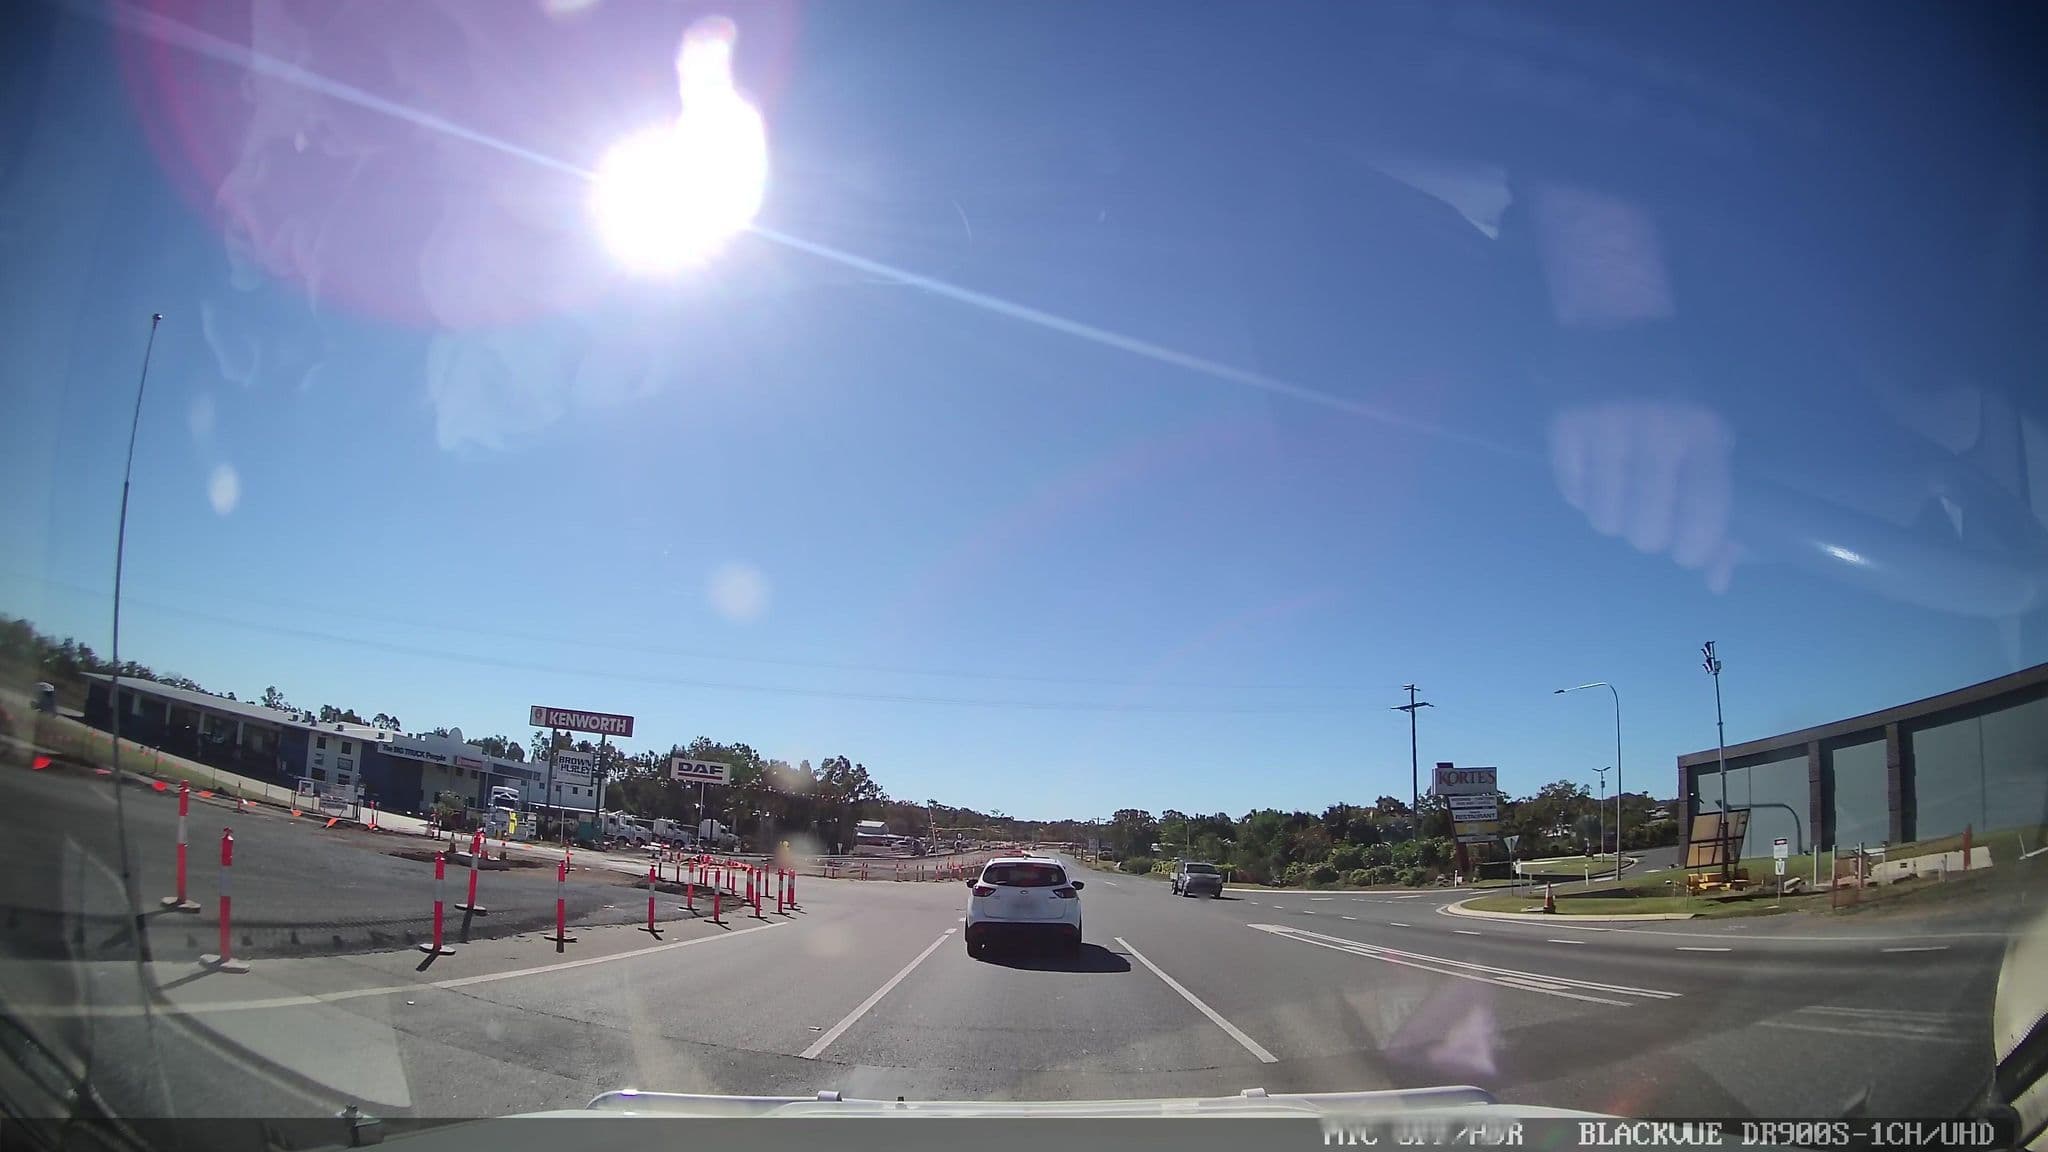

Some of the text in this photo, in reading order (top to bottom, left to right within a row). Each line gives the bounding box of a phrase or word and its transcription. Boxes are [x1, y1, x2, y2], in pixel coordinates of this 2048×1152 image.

[549, 711, 627, 734] KENWORTH
[405, 748, 426, 758] TRUCK
[559, 755, 591, 767] BROWN
[678, 762, 723, 775] DAF
